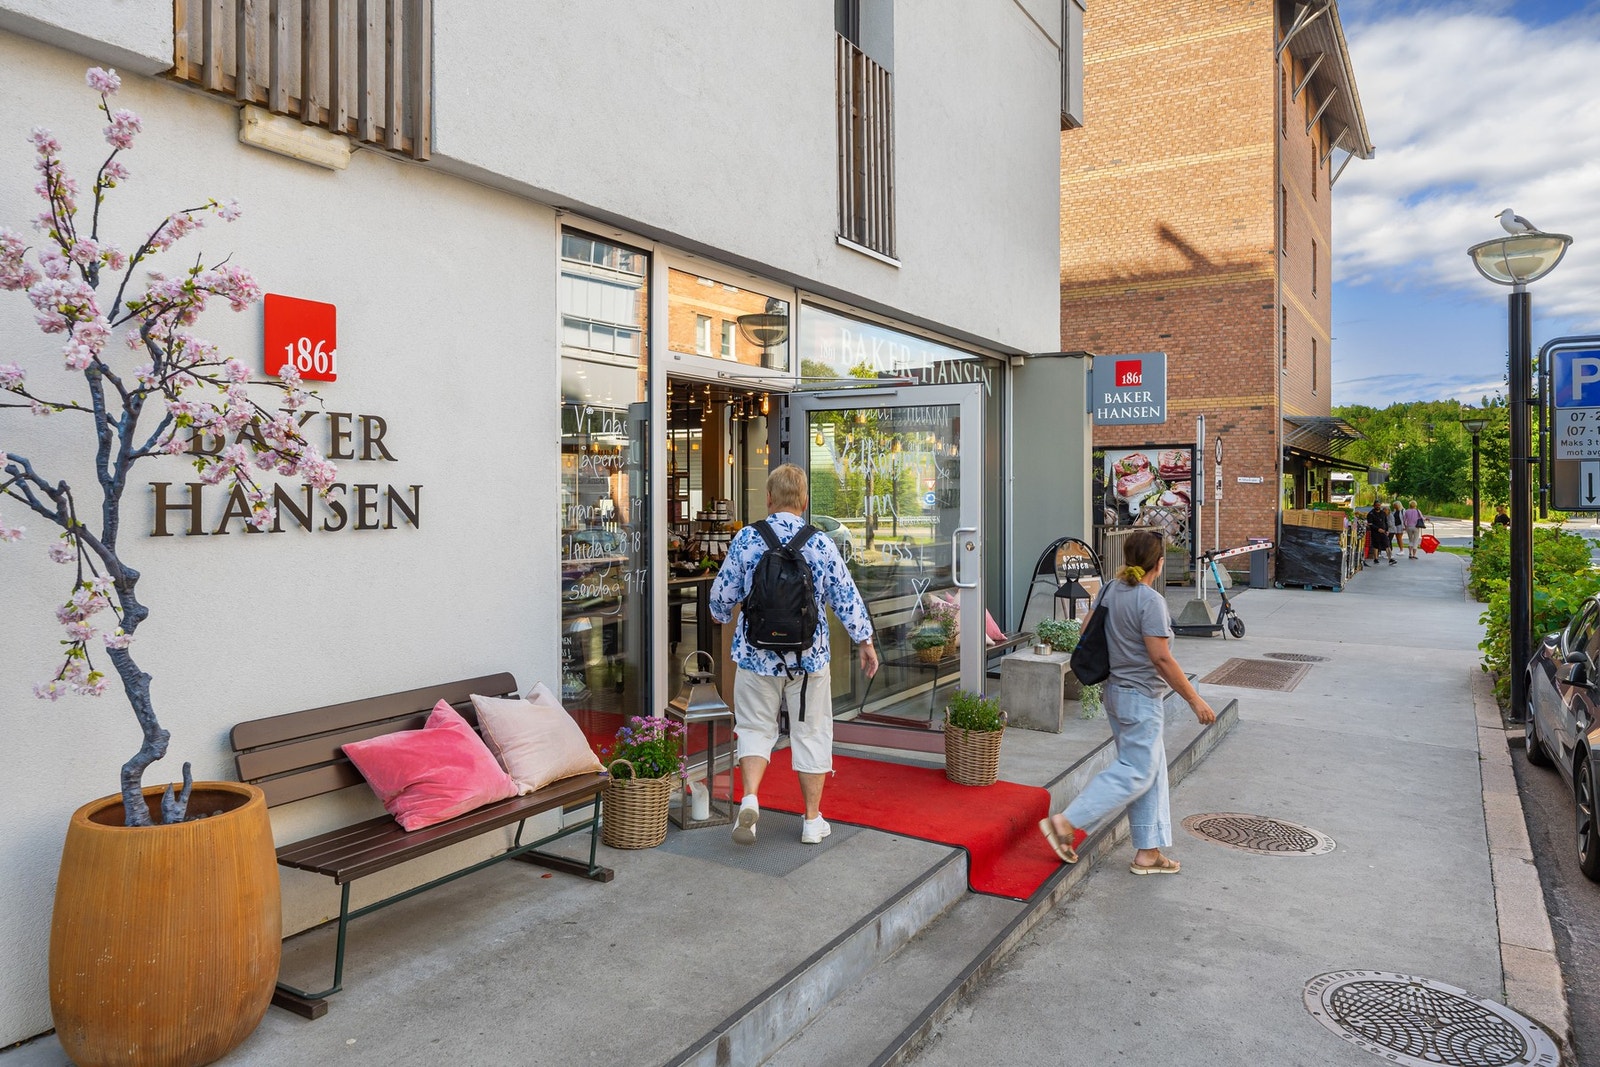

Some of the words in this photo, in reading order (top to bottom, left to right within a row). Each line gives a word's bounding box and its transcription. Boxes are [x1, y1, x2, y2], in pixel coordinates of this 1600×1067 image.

[284, 336, 337, 374] 1861
[841, 327, 913, 378] BAKER
[920, 351, 991, 397] HANSEN
[1121, 371, 1143, 385] 1861
[1572, 357, 1600, 400] P
[1104, 391, 1153, 404] BAKER
[574, 405, 594, 434] Vi
[1097, 406, 1161, 419] HANSEN
[1571, 412, 1586, 422] 07
[1567, 425, 1586, 437] (07
[1560, 439, 1583, 447] Maks
[1587, 438, 1592, 446] 3
[148, 481, 423, 537] HANSEN
